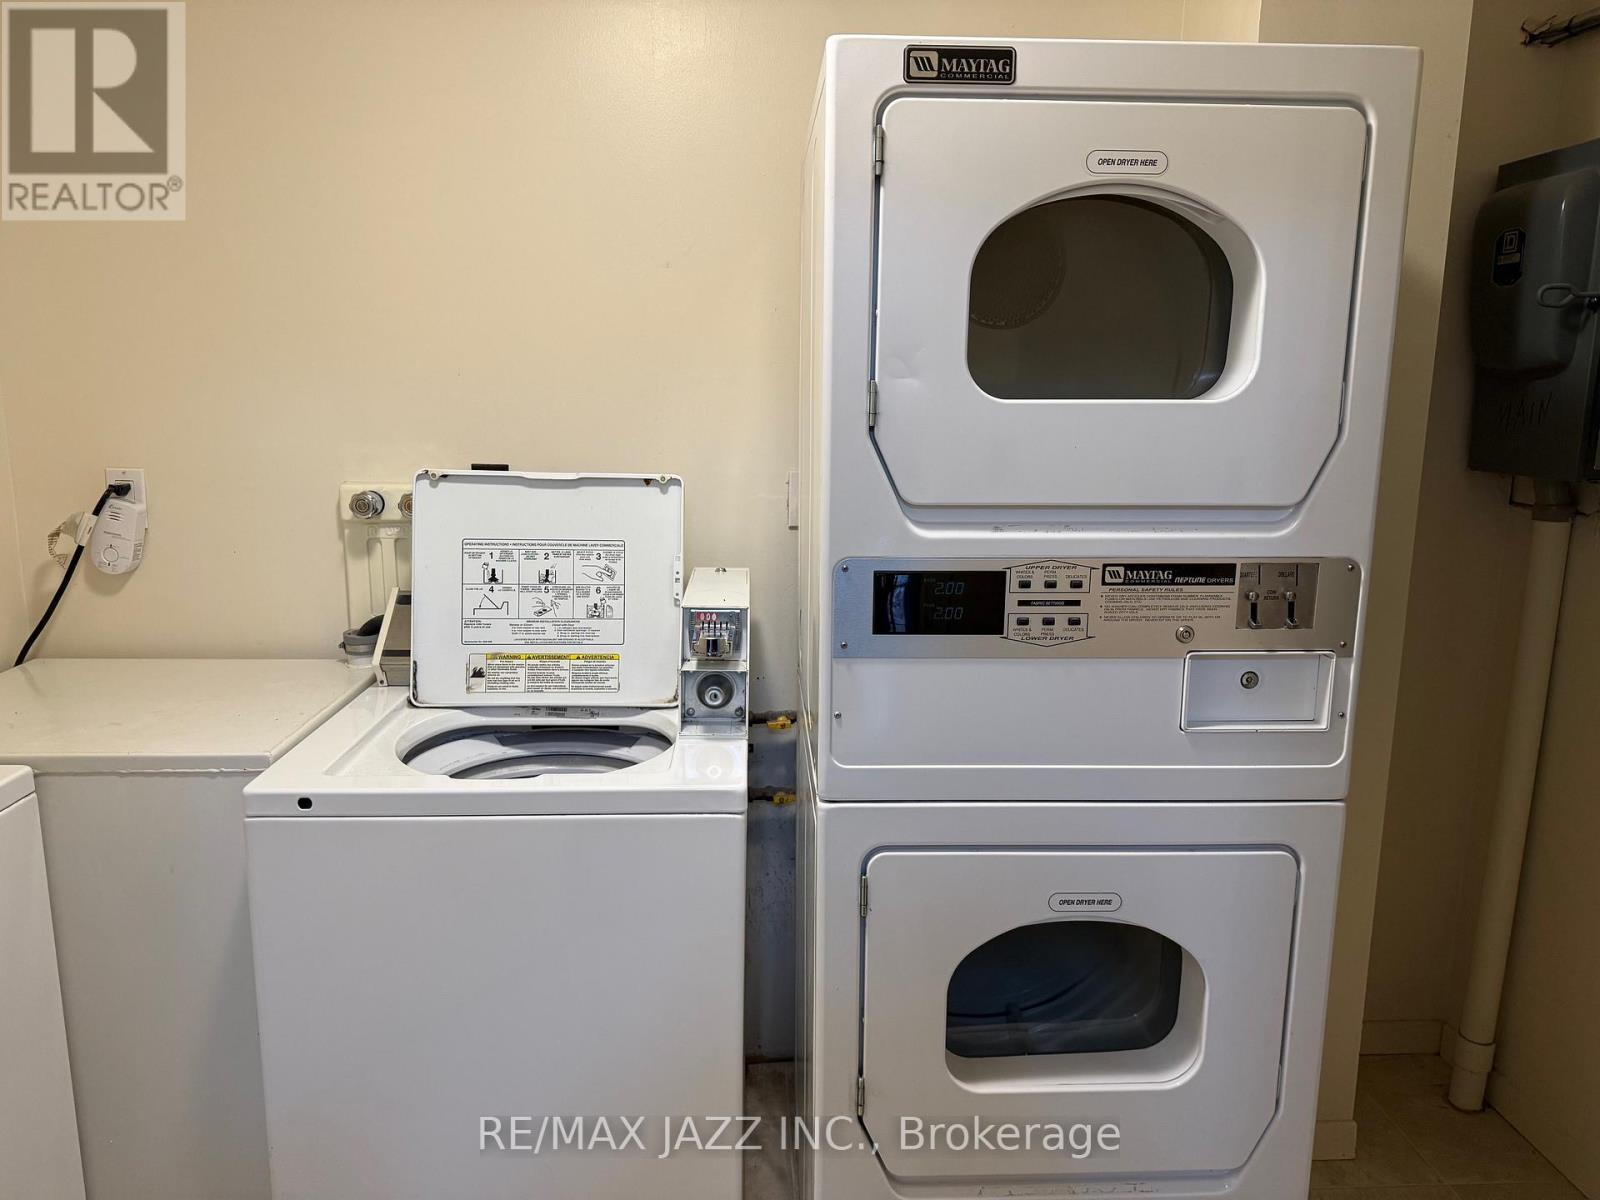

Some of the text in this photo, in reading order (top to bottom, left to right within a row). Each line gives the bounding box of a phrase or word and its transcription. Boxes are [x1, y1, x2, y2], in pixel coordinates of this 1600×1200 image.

[941, 58, 1010, 73] MAYTAG
[1097, 158, 1158, 167] OPEN DRYER HERE
[544, 552, 550, 560] 2
[1125, 570, 1173, 580] MAYTAG
[934, 582, 965, 595] 2.00
[933, 607, 964, 620] 2.00
